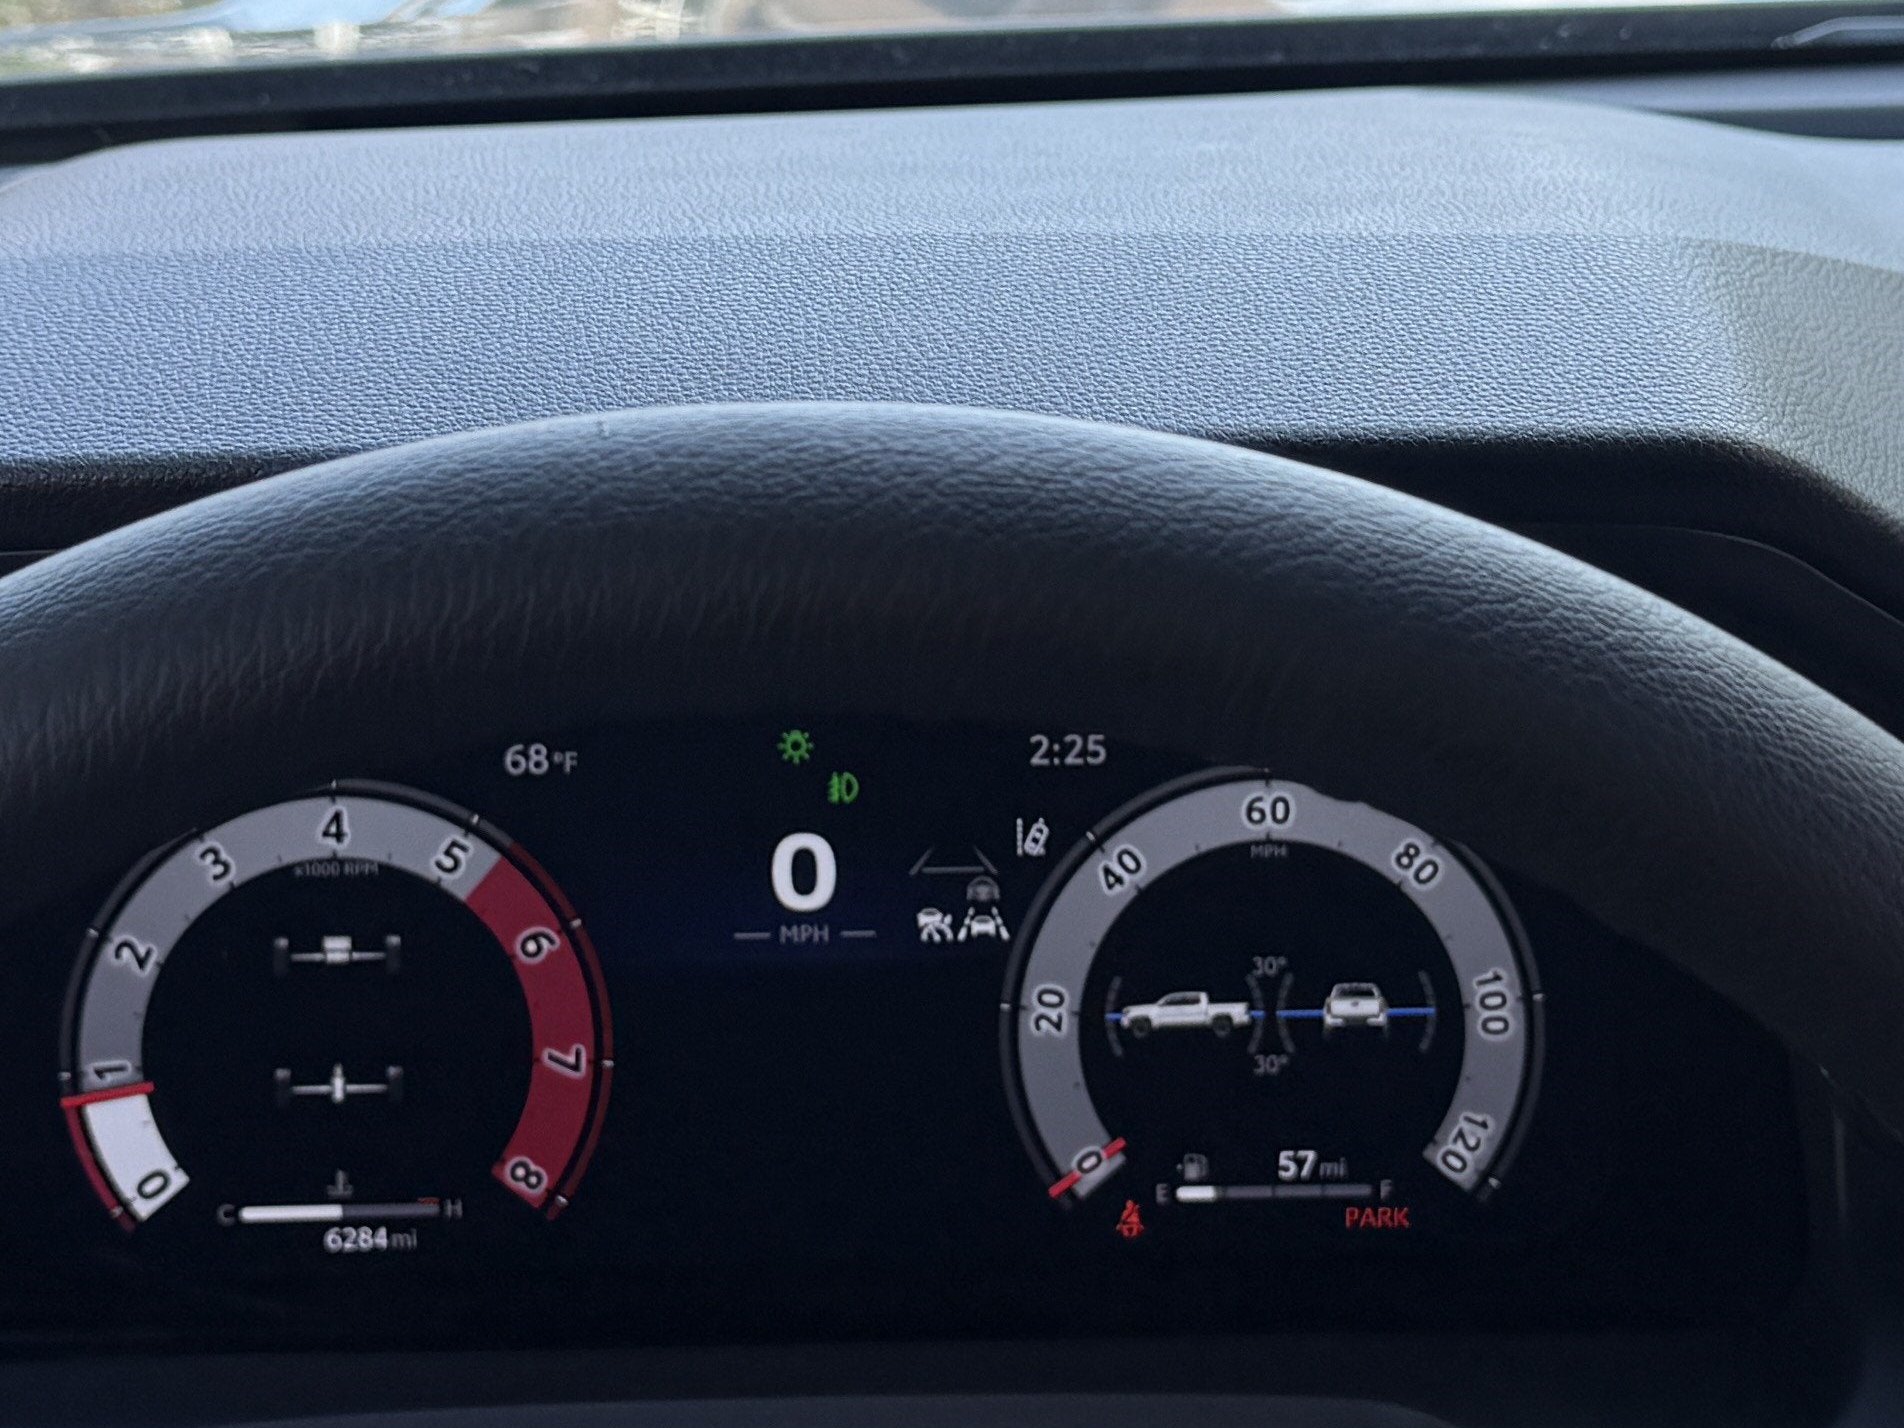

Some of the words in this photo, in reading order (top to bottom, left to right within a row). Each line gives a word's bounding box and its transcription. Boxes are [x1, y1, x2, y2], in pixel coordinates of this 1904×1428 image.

[1029, 734, 1107, 766] 2:25
[1245, 795, 1292, 826] 60
[321, 810, 349, 844] 4
[199, 846, 235, 882] 3
[437, 840, 469, 875] 5
[770, 831, 837, 912] 0
[1100, 847, 1142, 892] 40
[1393, 844, 1439, 887] 80
[520, 930, 556, 959] 6
[779, 924, 830, 945] MPH
[115, 939, 154, 971] 2
[1032, 986, 1066, 1034] 20
[1477, 971, 1511, 1037] 100
[94, 1060, 130, 1083] 1
[547, 1048, 583, 1073] 7
[1440, 1111, 1490, 1175] 120
[510, 1160, 544, 1190] 8
[1076, 1149, 1103, 1176] 0
[137, 1170, 169, 1200] 0
[1156, 1182, 1169, 1205] E
[1380, 1179, 1394, 1199] F
[1345, 1206, 1411, 1229] PARK
